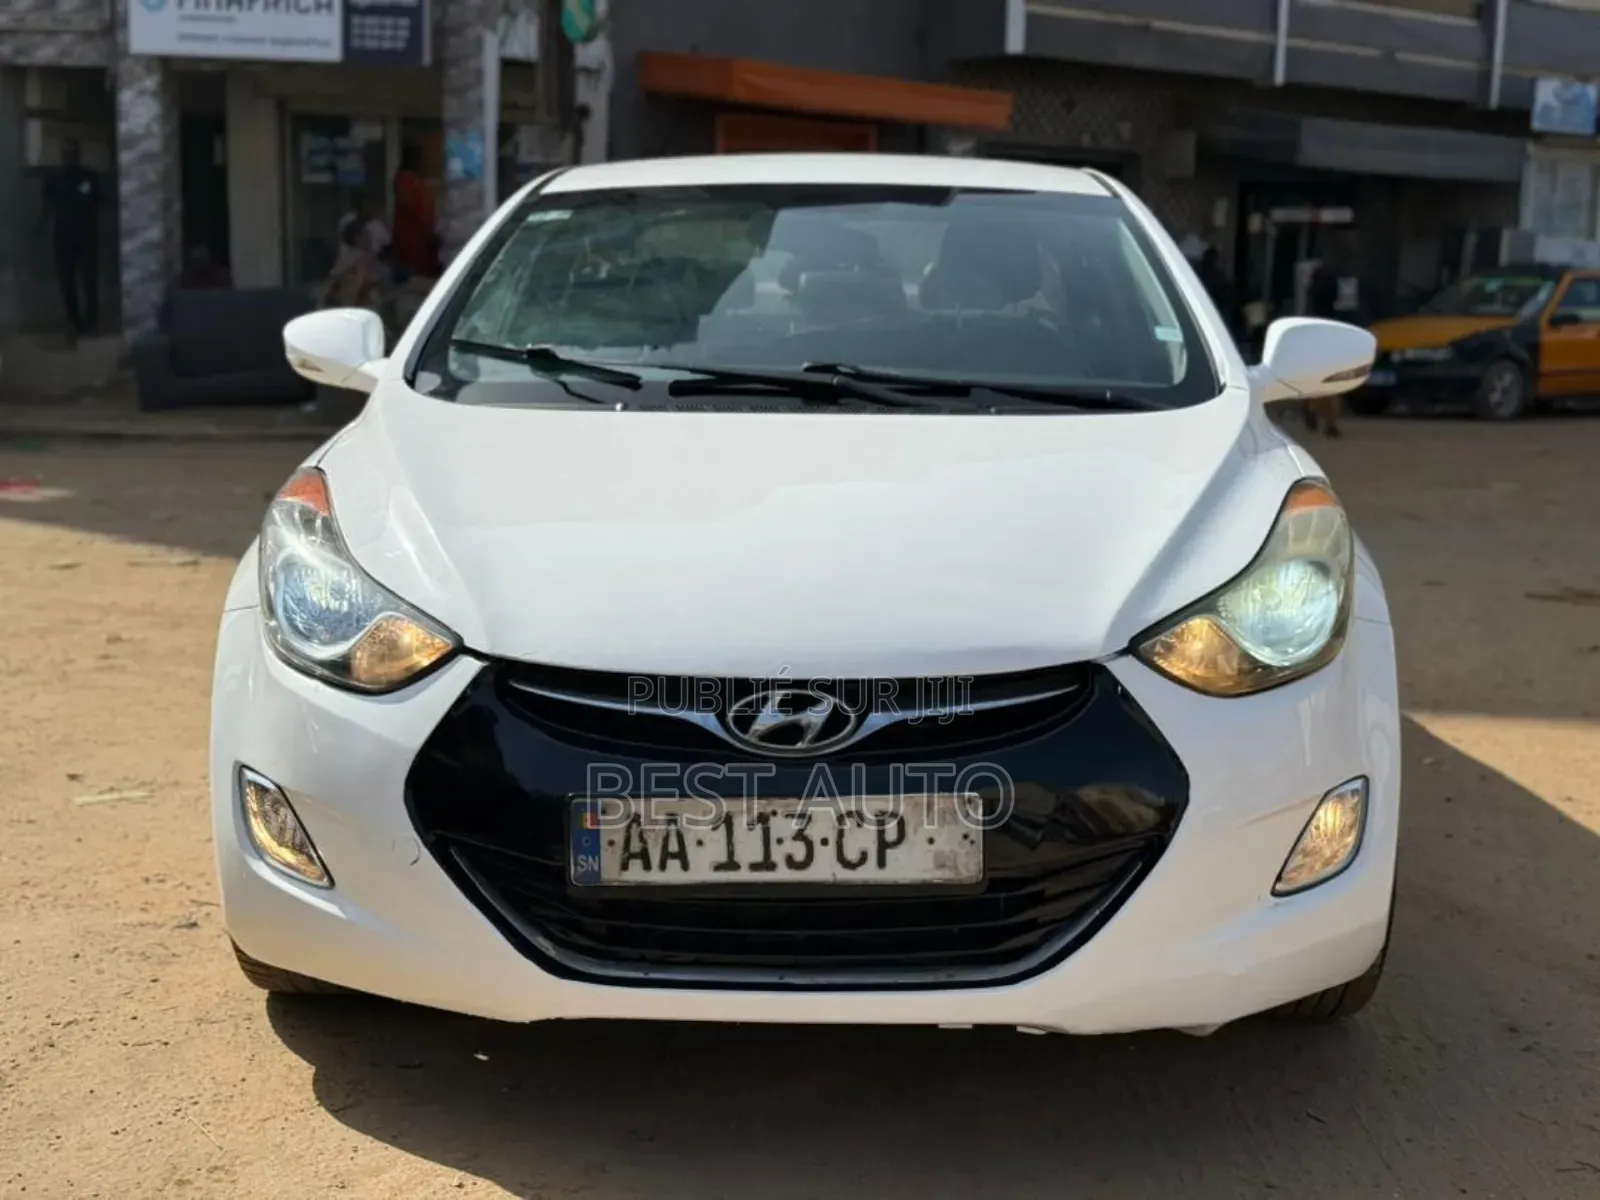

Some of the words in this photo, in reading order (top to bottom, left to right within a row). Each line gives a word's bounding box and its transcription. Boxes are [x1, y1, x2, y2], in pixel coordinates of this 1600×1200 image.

[620, 811, 691, 873] AA
[710, 811, 815, 873] 113
[835, 809, 907, 871] CP
[576, 854, 600, 873] SN
